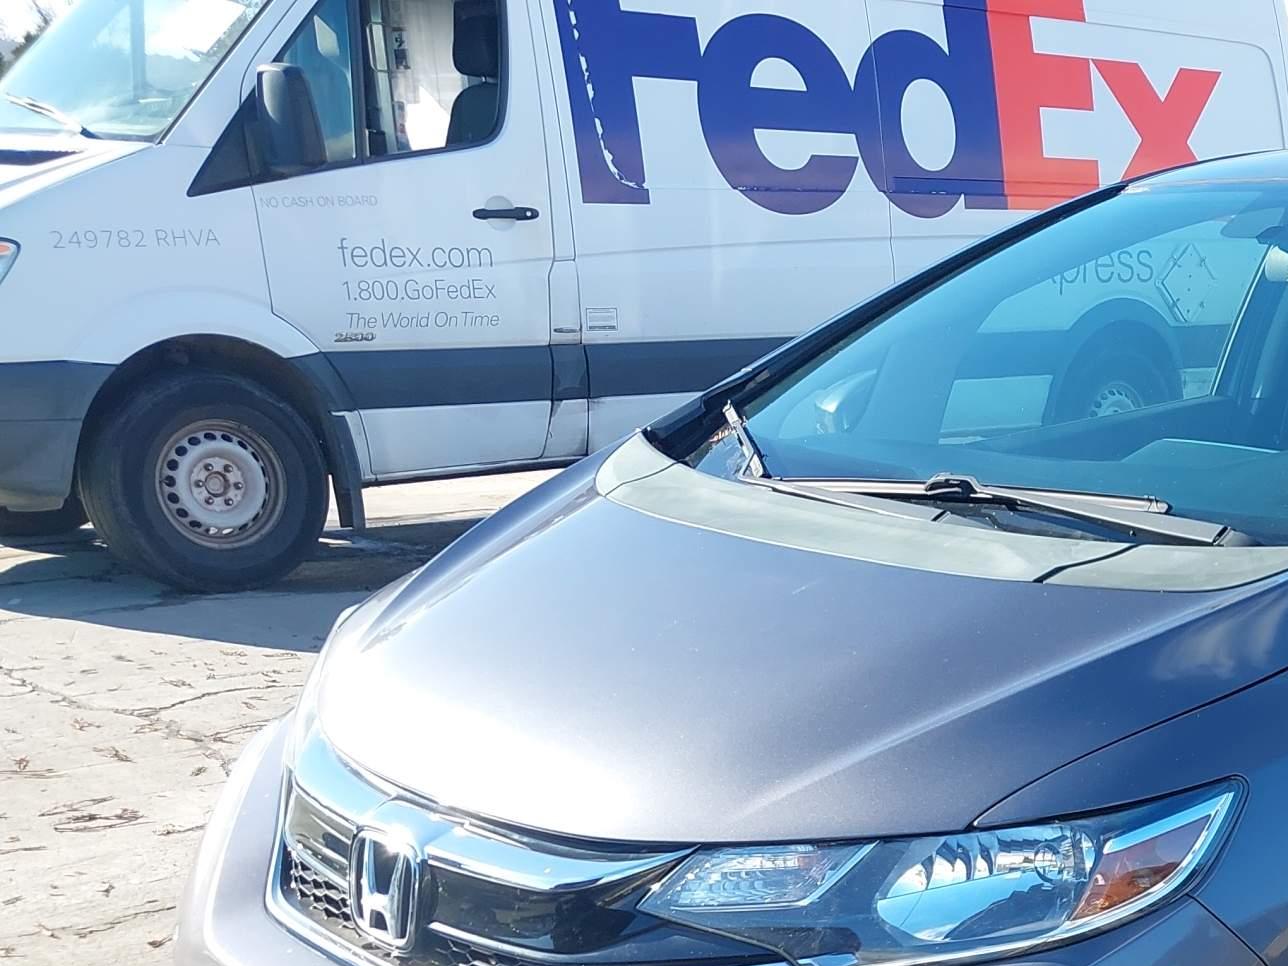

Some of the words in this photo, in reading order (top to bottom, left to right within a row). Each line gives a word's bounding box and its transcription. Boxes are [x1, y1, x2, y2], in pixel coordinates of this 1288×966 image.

[551, 0, 1222, 219] FedEx
[260, 196, 279, 208] NO
[281, 196, 313, 208] CASH
[317, 195, 335, 207] ON
[337, 194, 379, 207] BOARD
[49, 229, 148, 249] 249782
[154, 228, 221, 248] RHVA
[337, 237, 494, 269] fedex.com
[342, 278, 497, 301] 1.800.GoFedEx
[346, 312, 377, 329] The
[381, 311, 430, 329] World
[434, 311, 458, 327] On
[461, 311, 500, 327] Time
